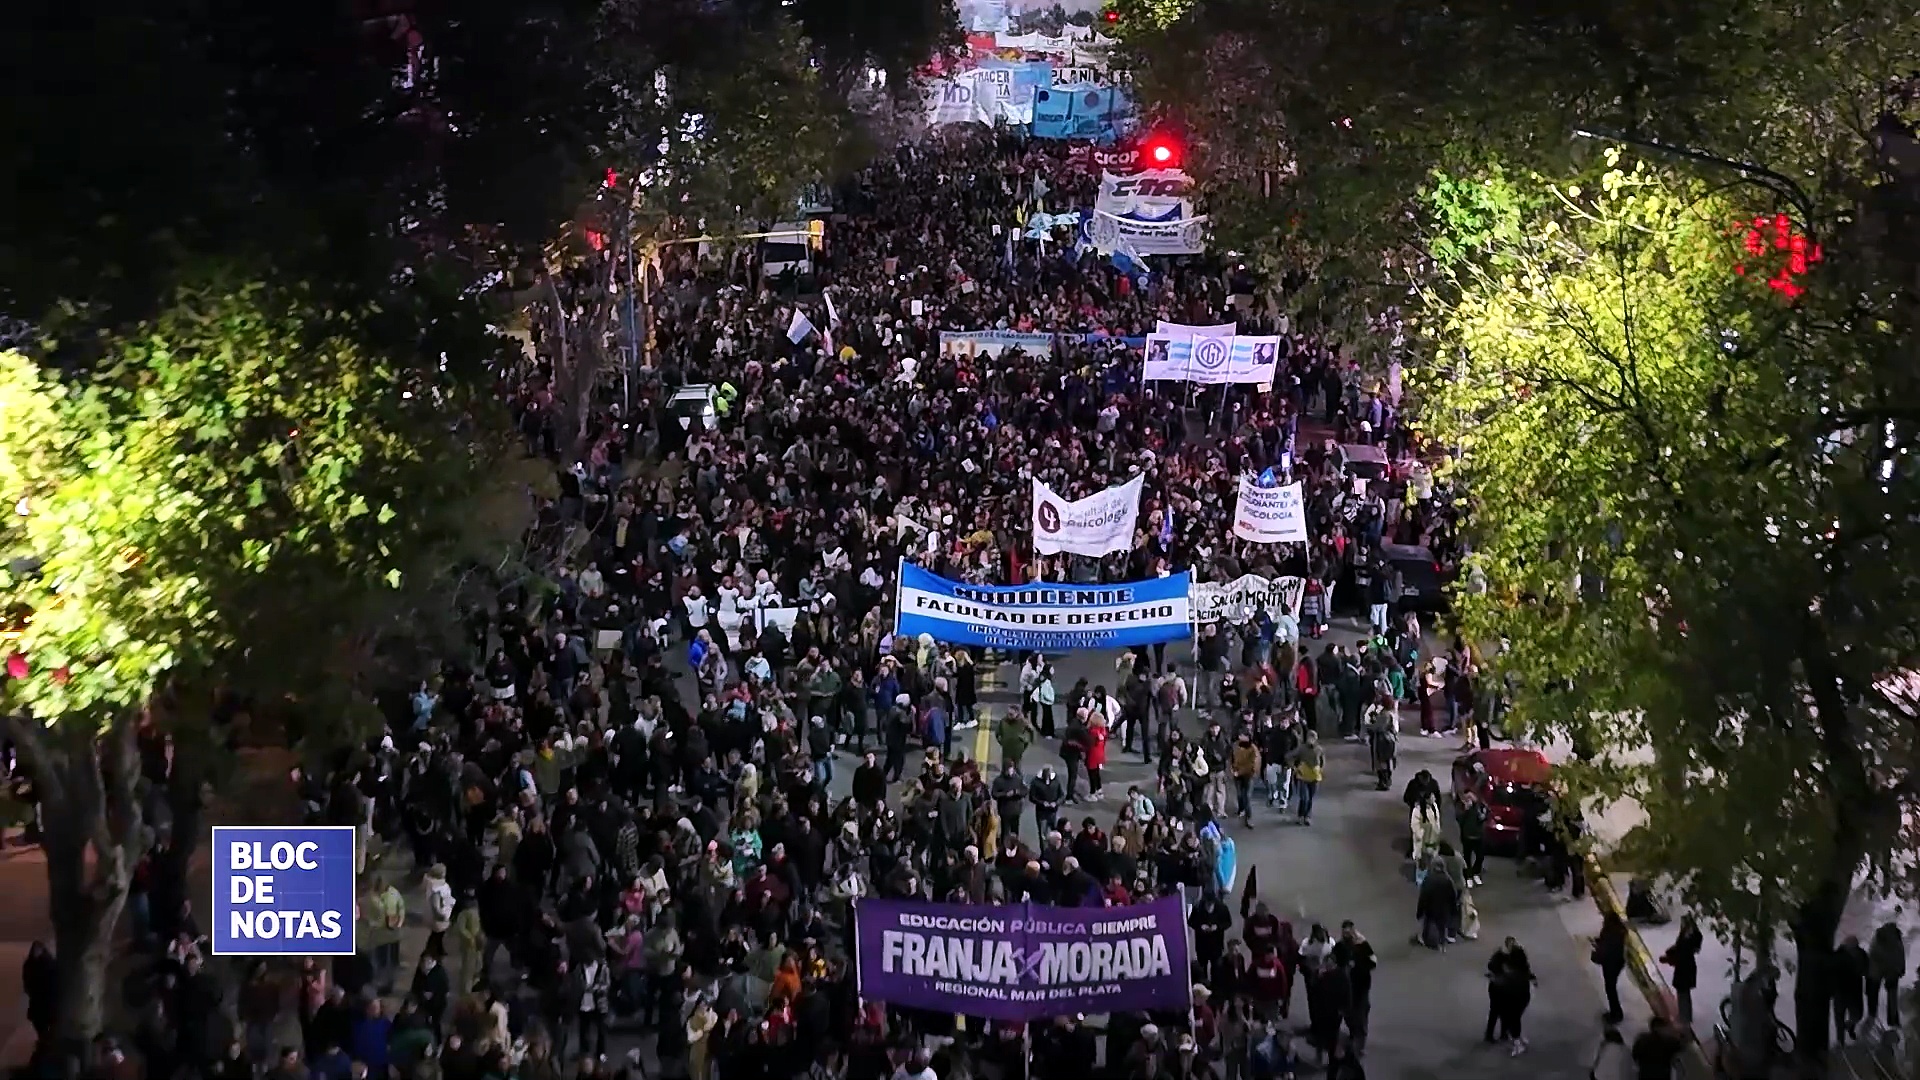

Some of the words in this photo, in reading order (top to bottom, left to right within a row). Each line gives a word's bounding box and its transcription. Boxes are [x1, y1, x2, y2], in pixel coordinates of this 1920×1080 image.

[1094, 150, 1140, 165] CICOP
[916, 597, 1026, 625] FACULTAD
[1032, 614, 1060, 625] DE
[1066, 605, 1173, 625] DERECHO
[899, 913, 1005, 933] EDUCACIÓN
[1010, 916, 1087, 935] PÚBLICA
[1091, 915, 1157, 935] SIEMPRE
[882, 930, 1019, 985] FRANJA
[1039, 934, 1171, 985] MORADA
[935, 981, 1007, 1000] REGIONAL
[1010, 988, 1046, 1001] MAR
[1049, 988, 1075, 998] DEL
